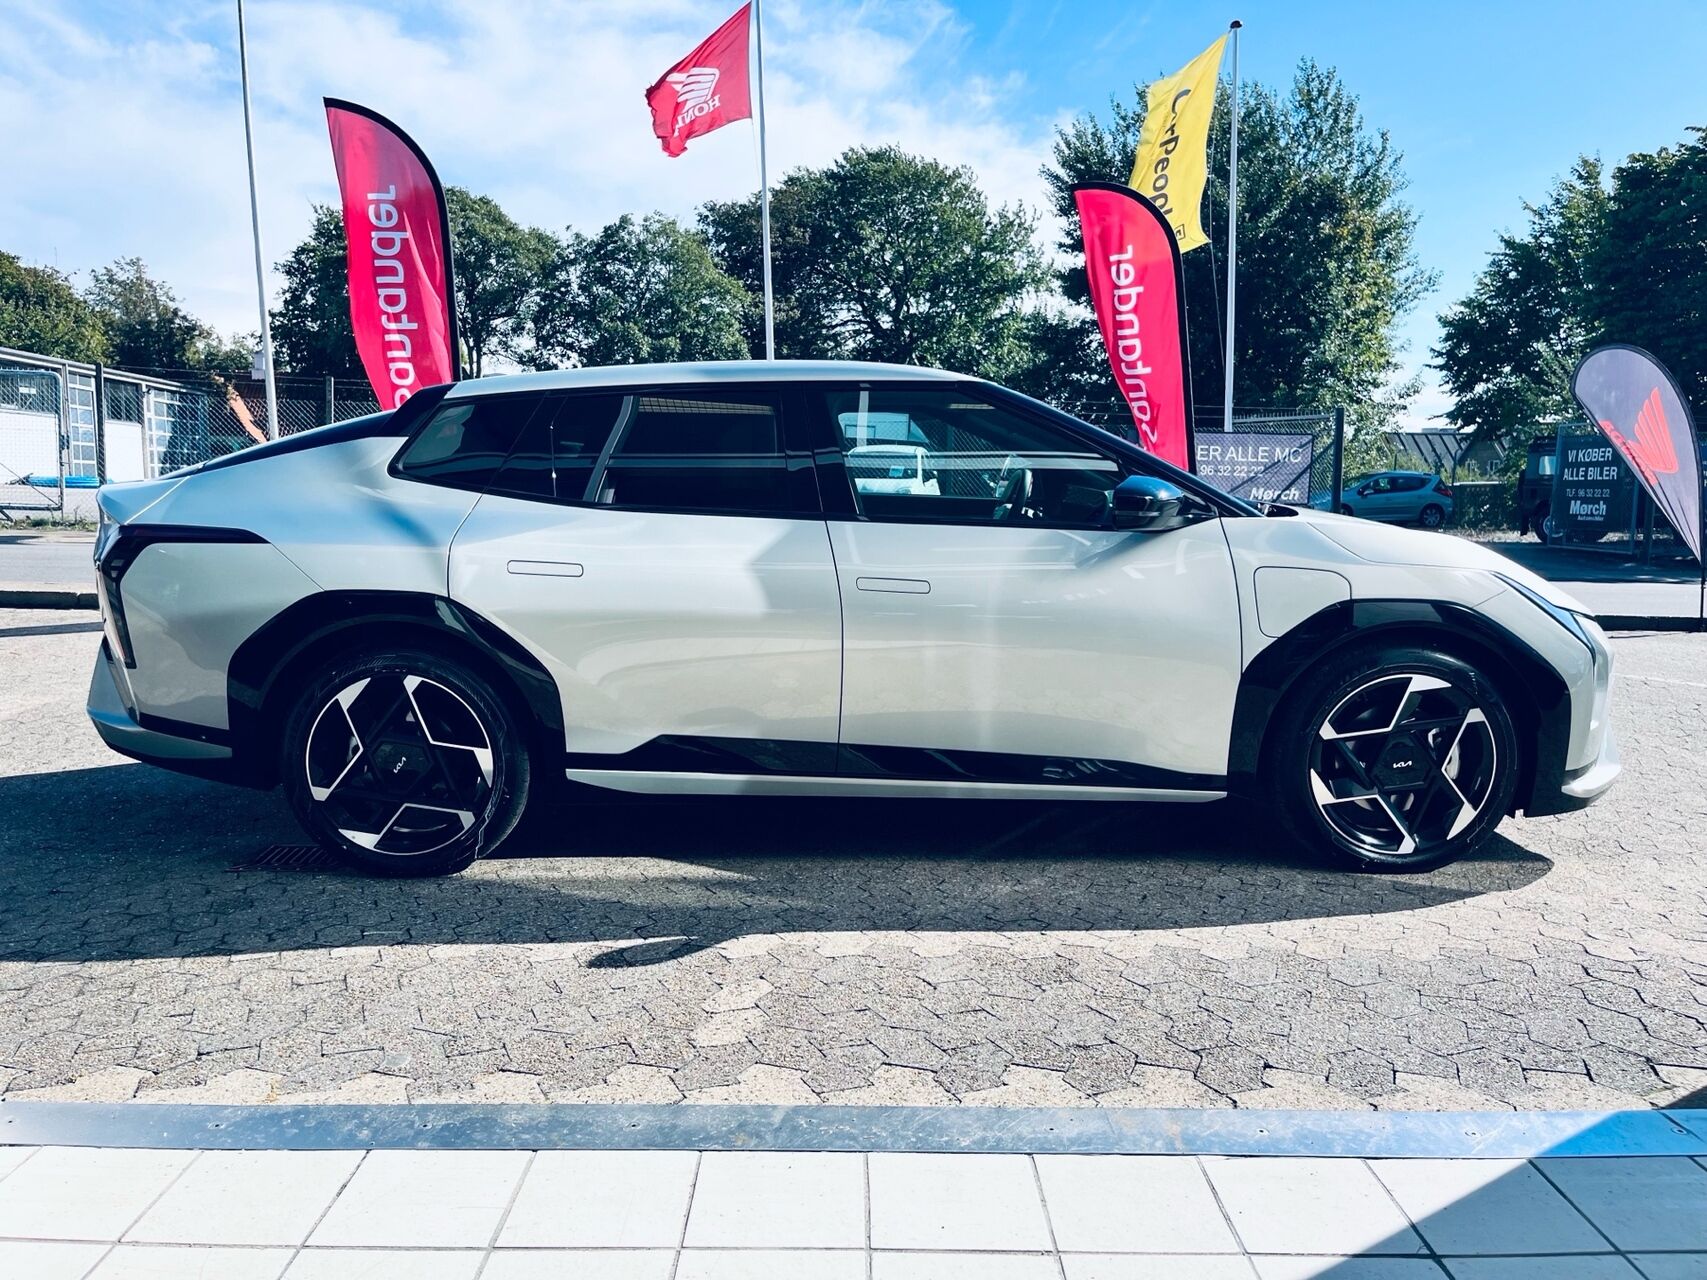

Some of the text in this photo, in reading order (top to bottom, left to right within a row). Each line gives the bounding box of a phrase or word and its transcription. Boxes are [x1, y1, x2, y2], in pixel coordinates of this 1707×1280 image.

[1225, 446, 1269, 462] ALLE
[1275, 447, 1301, 463] MC
[1568, 447, 1612, 462] VI KØBER
[1200, 464, 1264, 477] 96 32 22 22
[1563, 466, 1617, 480] ALLE BILER
[1250, 487, 1299, 501] Mørch
[1578, 488, 1585, 497] 96
[1586, 488, 1594, 497] 32
[1595, 488, 1602, 497] 22
[1603, 488, 1610, 497] 22
[1570, 500, 1606, 515] Mørch
